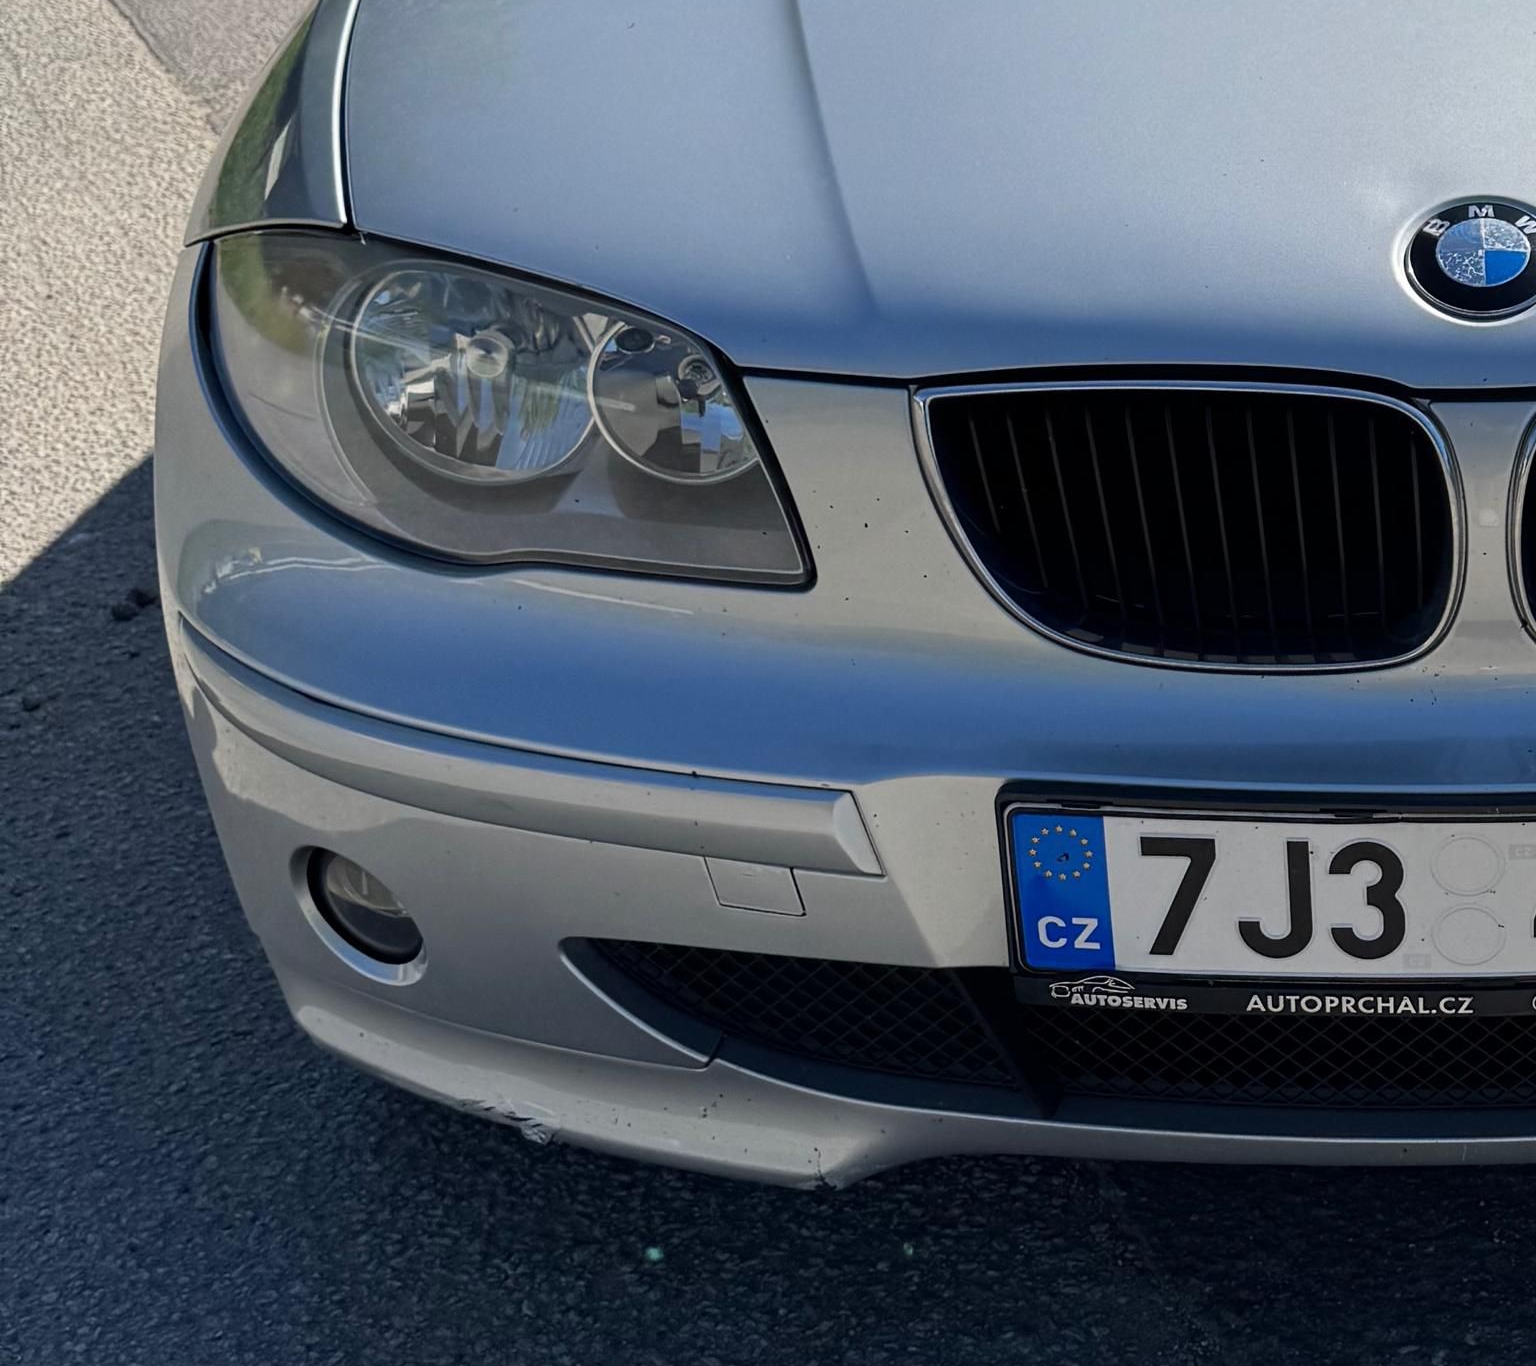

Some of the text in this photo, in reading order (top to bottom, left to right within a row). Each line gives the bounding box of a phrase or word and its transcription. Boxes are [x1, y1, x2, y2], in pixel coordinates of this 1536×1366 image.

[1140, 836, 1407, 959] 7J3
[1037, 916, 1101, 950] CZ
[1070, 993, 1188, 1011] AUTOSERVIS
[1246, 993, 1474, 1015] AUTOPRCHAL.CZ
